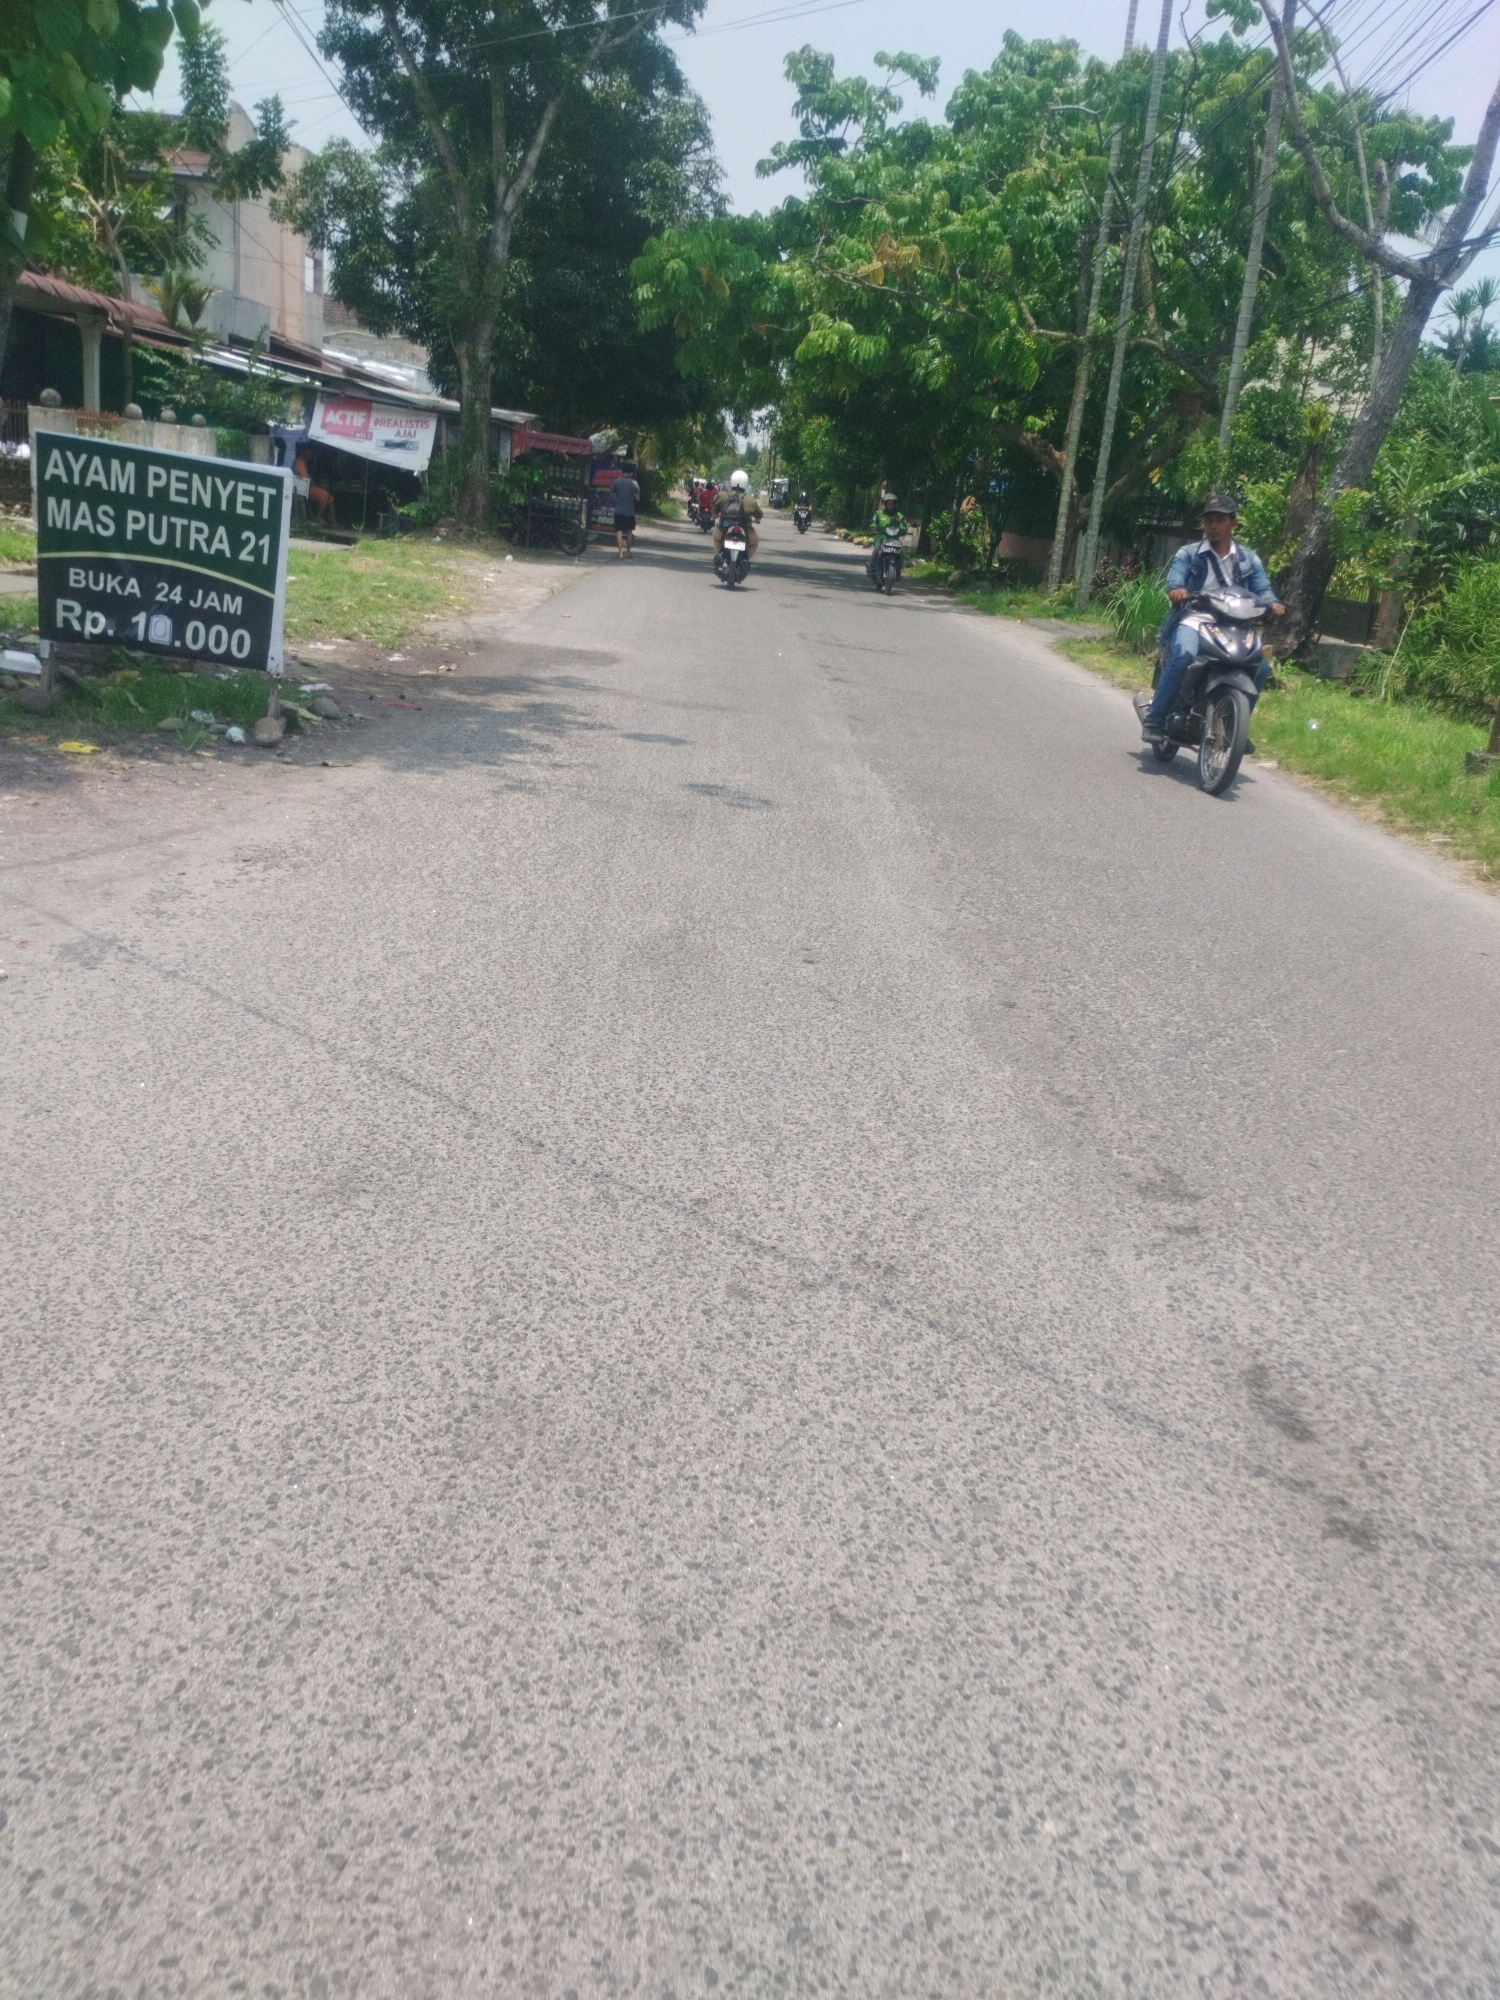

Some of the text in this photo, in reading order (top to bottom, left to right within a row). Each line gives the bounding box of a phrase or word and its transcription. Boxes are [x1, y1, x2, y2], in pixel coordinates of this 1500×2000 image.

[325, 408, 366, 427] ACTIF
[374, 417, 430, 429] #REALISTIS
[44, 448, 277, 520] AYAM PENYET
[47, 497, 271, 565] MAS PUTRA 21
[69, 567, 243, 616] BUKA 24 JAM
[55, 598, 114, 640] Rp.
